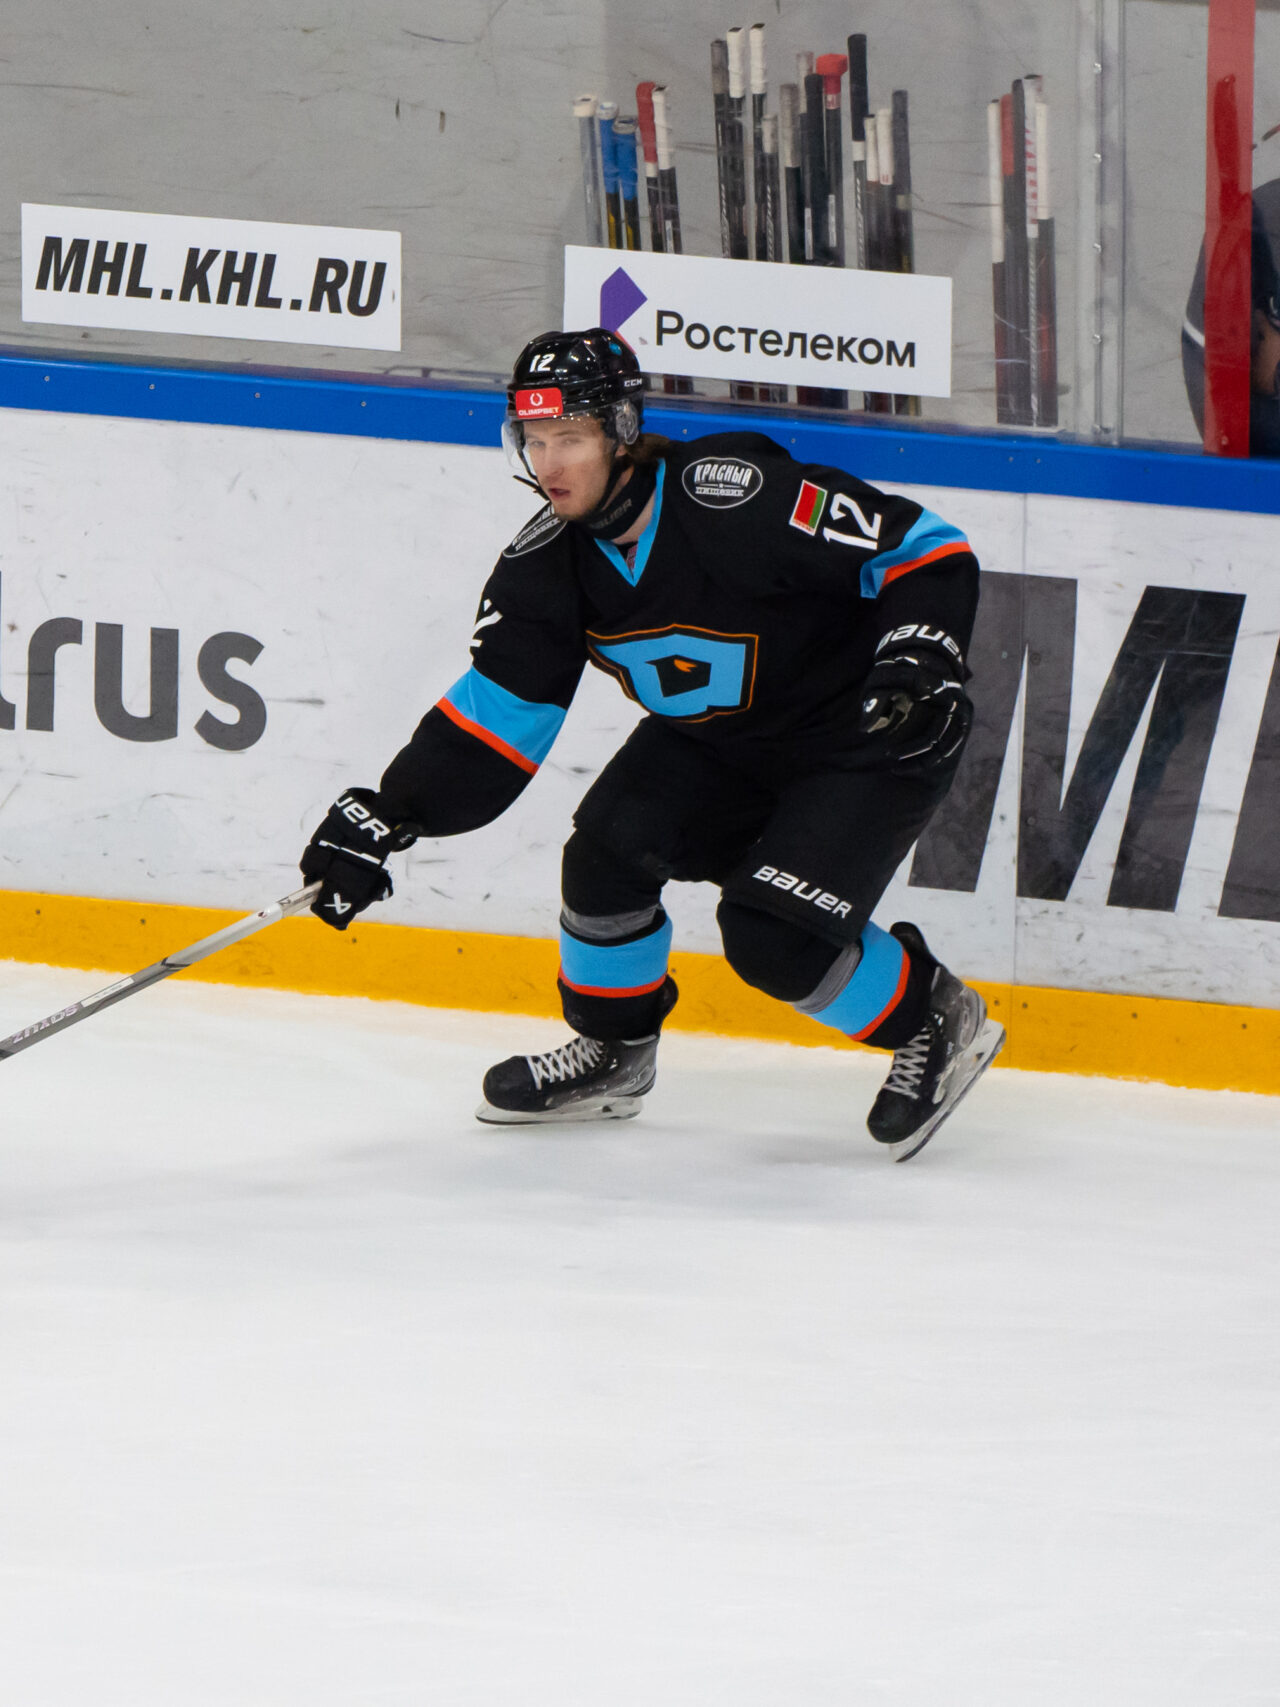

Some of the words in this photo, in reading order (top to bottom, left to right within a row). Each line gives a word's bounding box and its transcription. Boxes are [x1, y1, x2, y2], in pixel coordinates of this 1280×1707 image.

[35, 235, 388, 317] MHL.KHL.RU
[529, 353, 556, 373] 12
[655, 309, 916, 368] Ростелеком
[518, 406, 560, 417] OLIMPBET
[822, 492, 882, 551] 12
